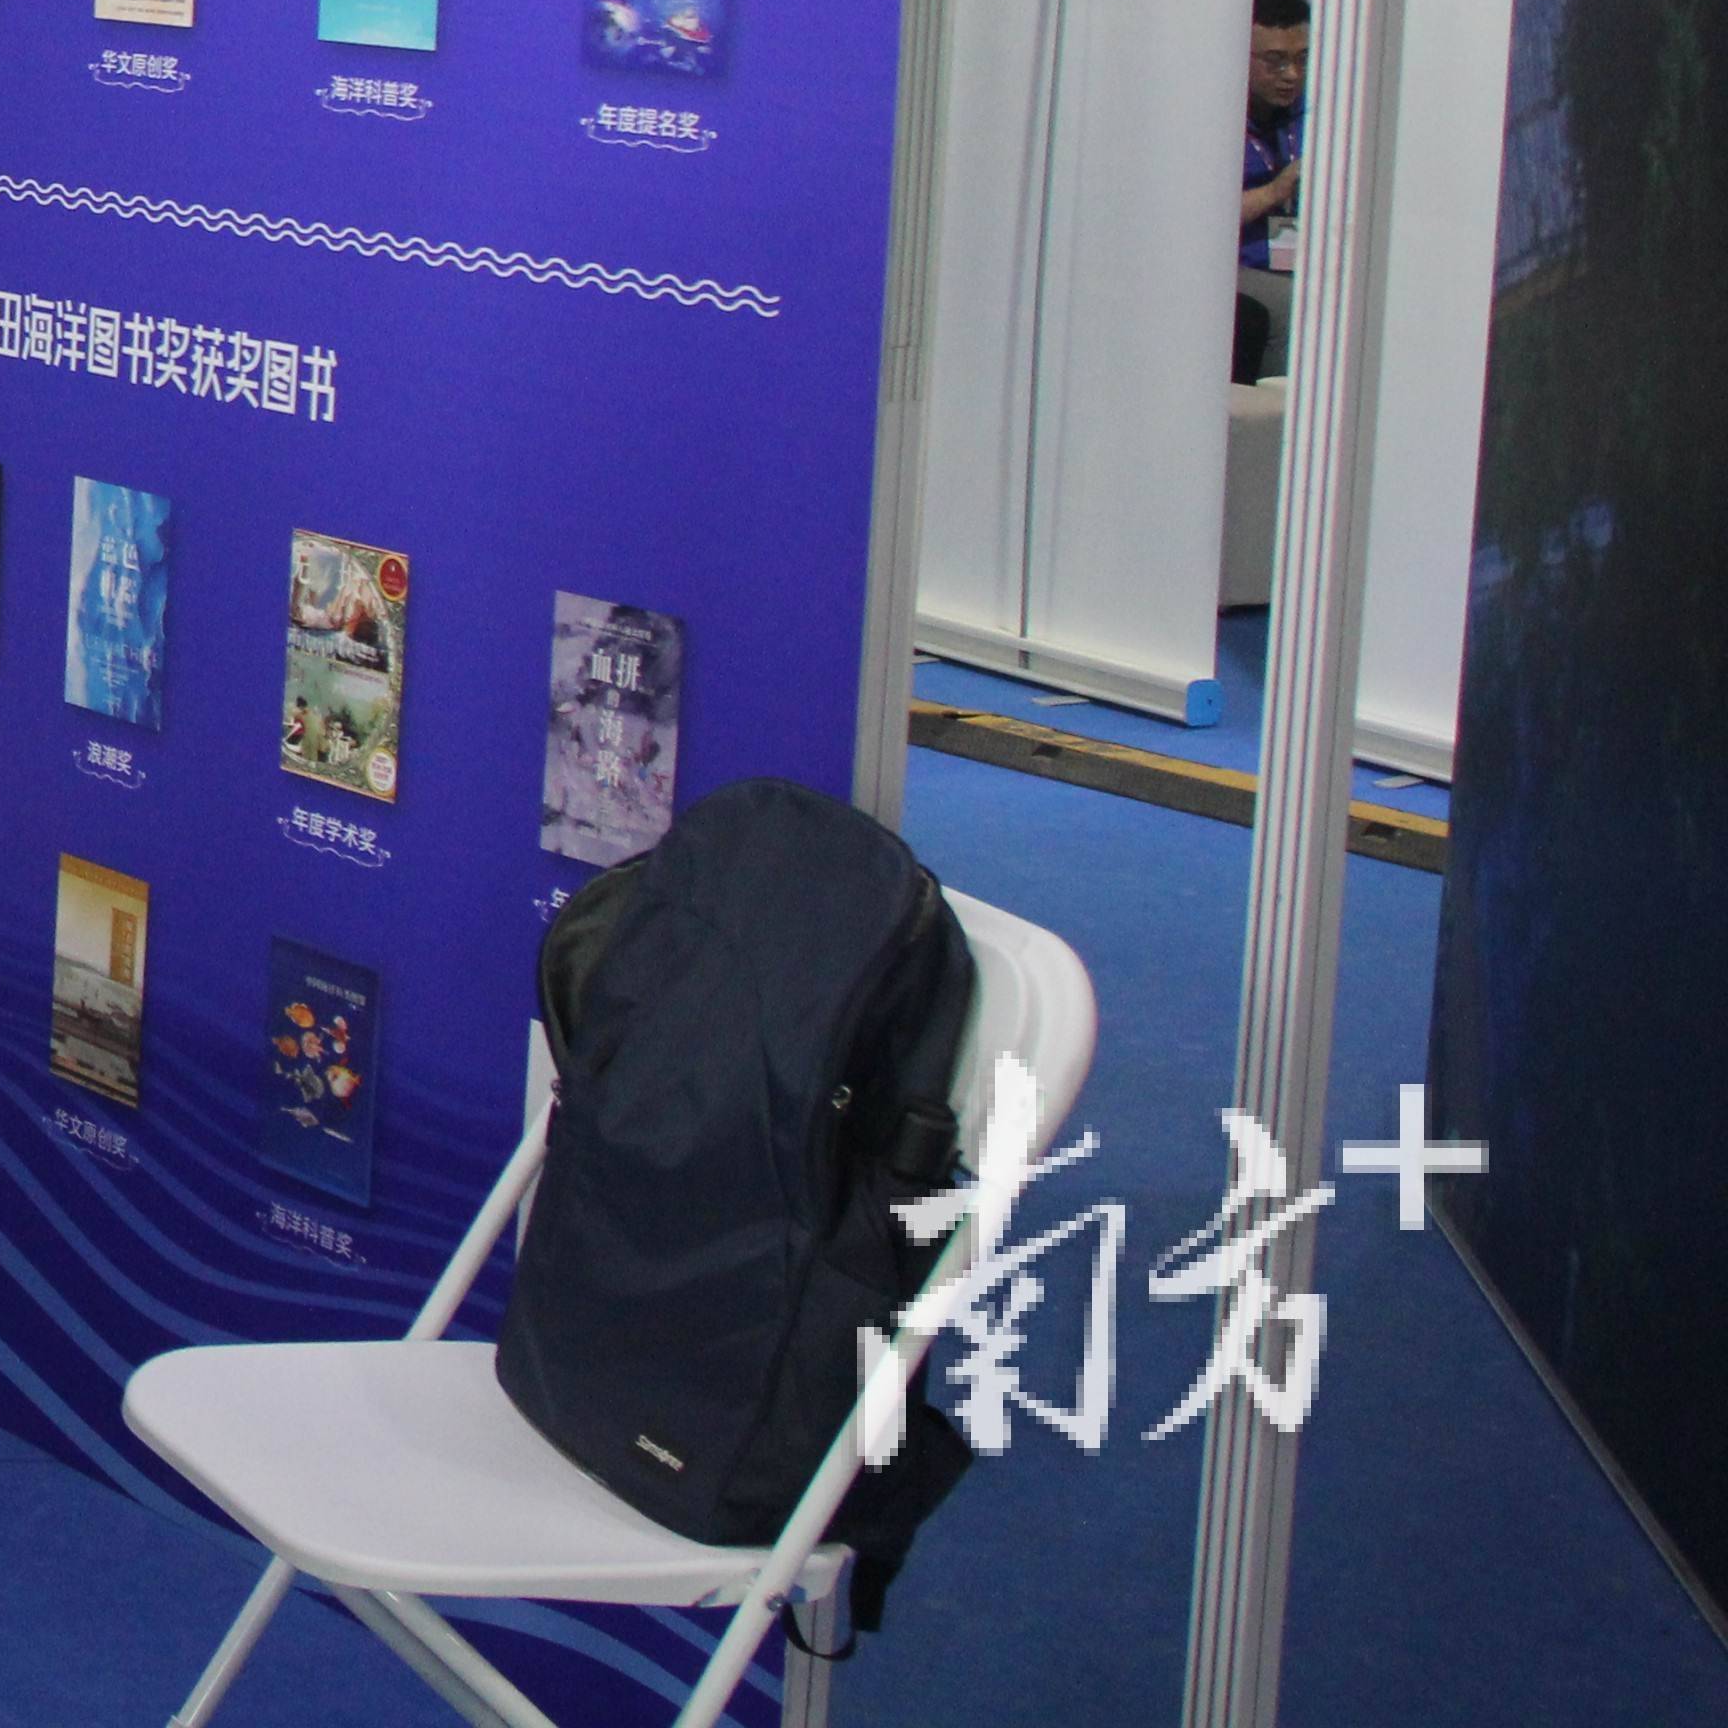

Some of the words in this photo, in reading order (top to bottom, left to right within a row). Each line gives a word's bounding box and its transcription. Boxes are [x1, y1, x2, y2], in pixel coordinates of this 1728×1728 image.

[101, 50, 179, 81] 华文原创奖
[331, 76, 418, 109] 海洋科普奖
[598, 104, 700, 140] 年度提名奖
[87, 740, 132, 776] 浪潮奖
[292, 806, 378, 856] 年度学术奖
[54, 1107, 128, 1159] 华文原创奖
[270, 1201, 354, 1260] 海洋科普奖
